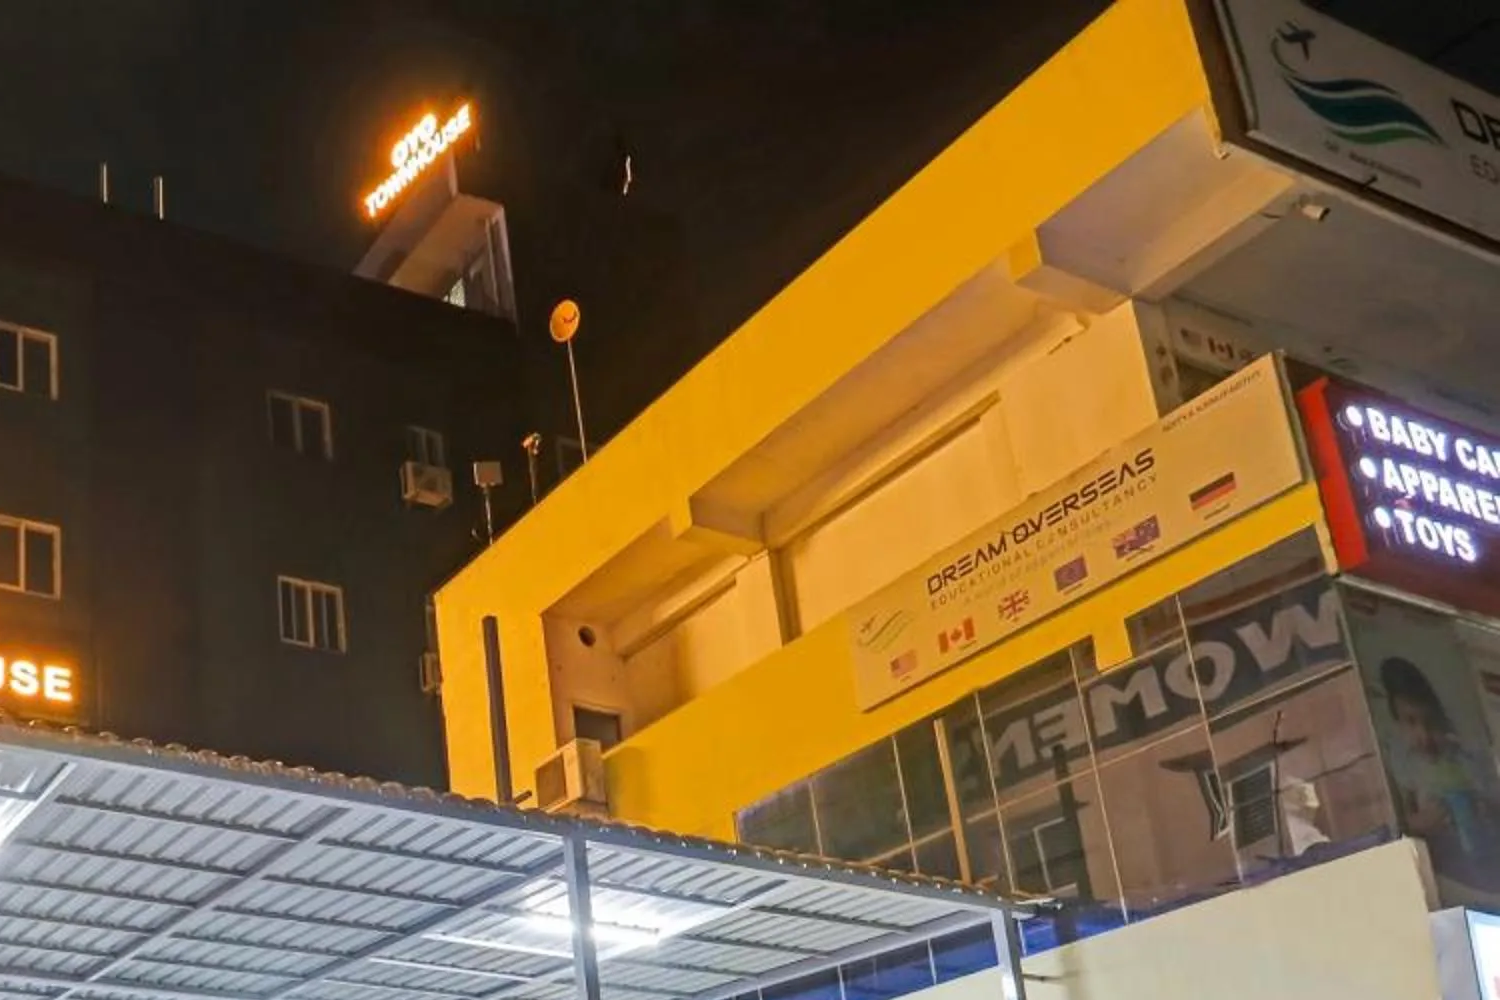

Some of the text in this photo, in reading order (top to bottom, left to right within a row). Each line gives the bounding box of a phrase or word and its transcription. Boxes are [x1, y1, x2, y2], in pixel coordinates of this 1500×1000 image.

[390, 112, 438, 168] OYO
[1365, 406, 1447, 462] BABY
[927, 533, 1007, 596] DREAM
[1012, 447, 1156, 544] OVERSEAS
[1393, 507, 1477, 563] TOYS
